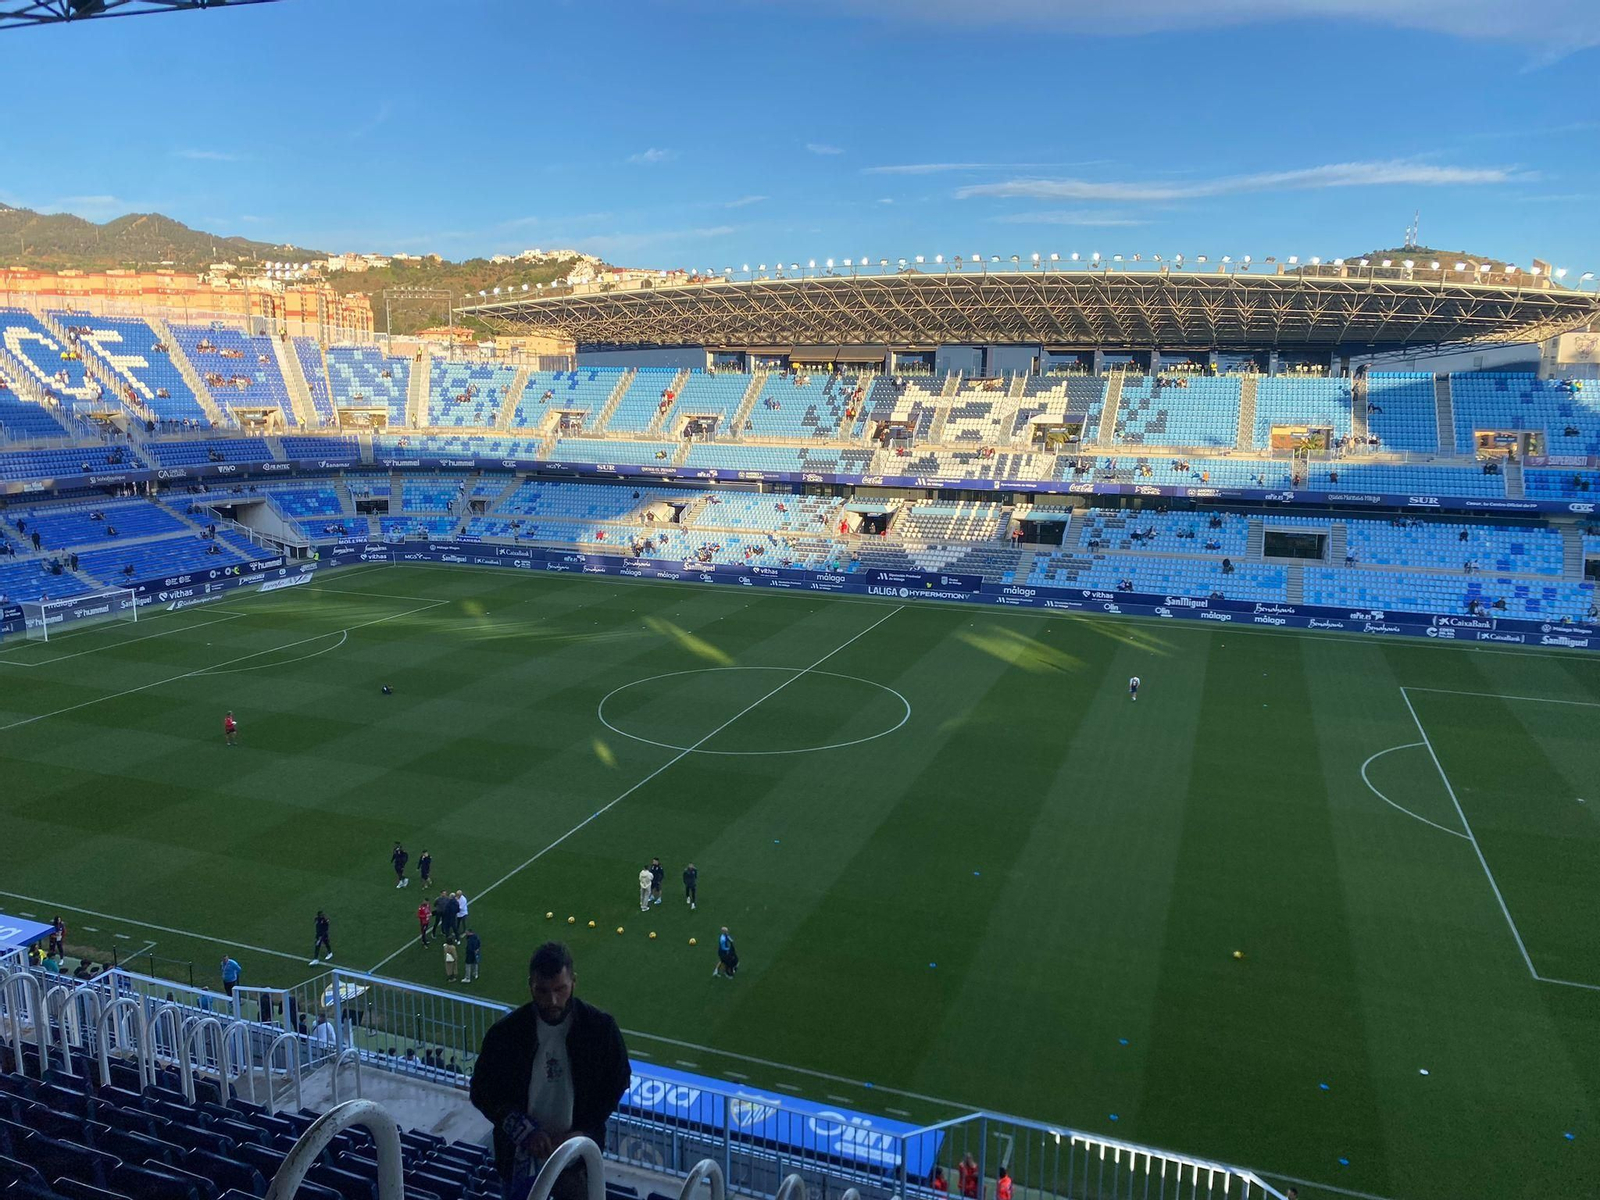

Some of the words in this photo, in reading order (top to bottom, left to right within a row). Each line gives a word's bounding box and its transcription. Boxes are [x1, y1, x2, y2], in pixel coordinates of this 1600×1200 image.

[392, 459, 420, 467] hummel
[448, 459, 475, 467] hummel
[1409, 496, 1439, 504] SUR
[505, 549, 530, 557] CaixaBank
[257, 557, 282, 570] hummel
[657, 571, 679, 580] málaga
[760, 568, 778, 576] vithas
[816, 572, 845, 583] málaga
[169, 589, 193, 599] vithas
[868, 586, 898, 596] LALIGA
[1003, 585, 1036, 597] málaga
[1092, 591, 1114, 599] vithas
[82, 605, 109, 617] hummel
[1103, 602, 1119, 610] Olin
[35, 614, 63, 627] hummel
[1201, 611, 1231, 622] málaga
[1254, 615, 1286, 626] málaga
[1450, 617, 1491, 629] CaixaBank
[1490, 633, 1520, 642] CaixaBank
[808, 1111, 894, 1151] Olin
